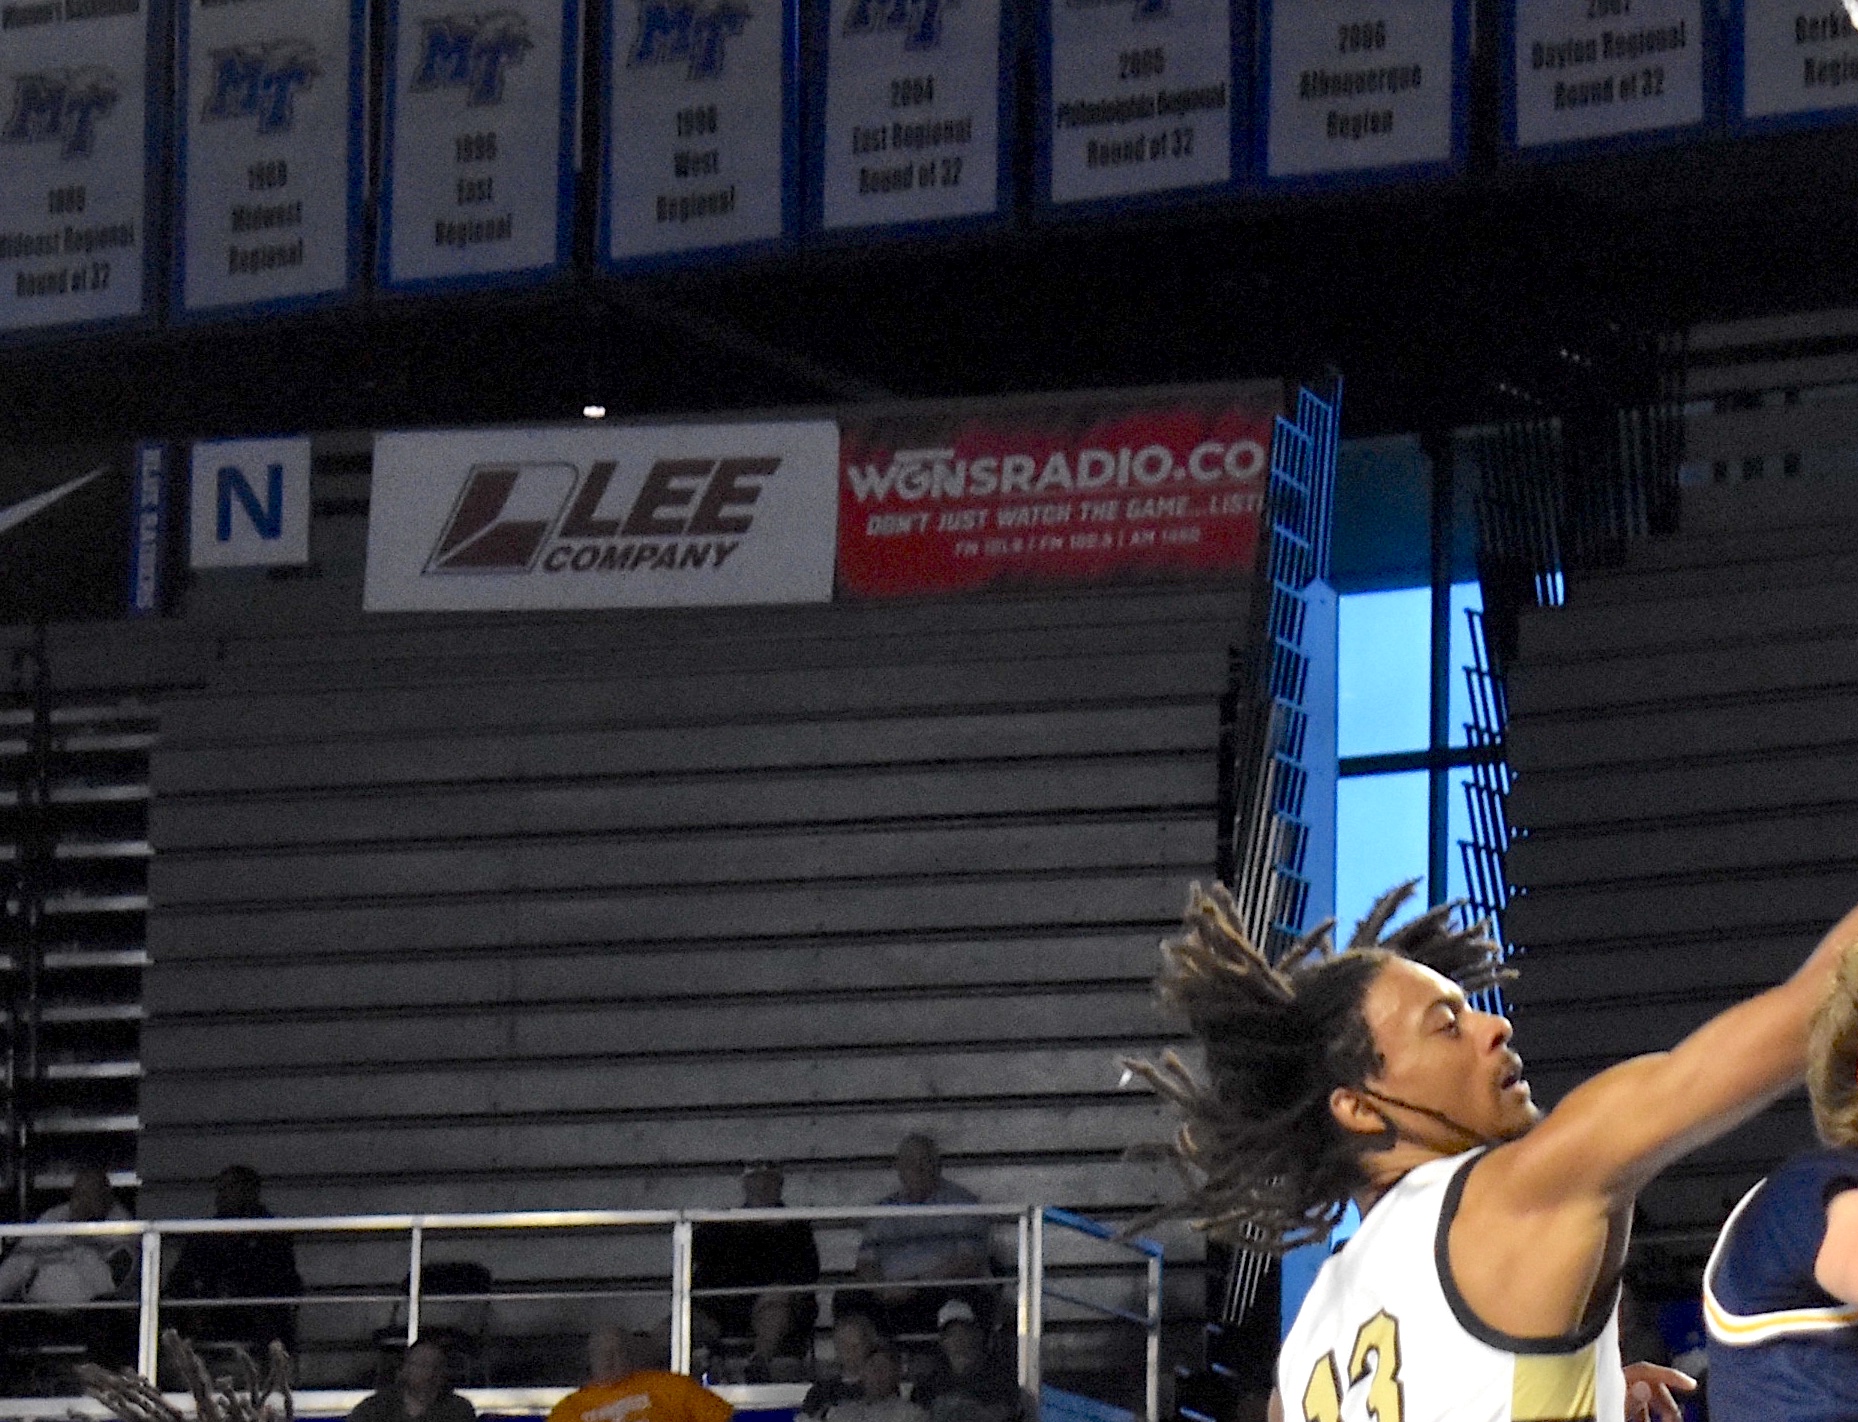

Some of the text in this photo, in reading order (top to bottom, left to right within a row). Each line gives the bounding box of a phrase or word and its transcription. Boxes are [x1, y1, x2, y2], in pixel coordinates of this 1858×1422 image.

[1602, 20, 1687, 60] Regional
[1554, 80, 1613, 111] Round
[1642, 67, 1665, 96] 32
[847, 441, 1265, 502] WGNSRADIO.CO
[216, 463, 283, 541] N
[560, 456, 781, 537] LEE
[866, 512, 929, 536] DON'T
[938, 508, 988, 532] JUST
[997, 504, 1072, 528] WATCH
[1080, 499, 1119, 522] THE
[542, 536, 739, 574] COMPANY
